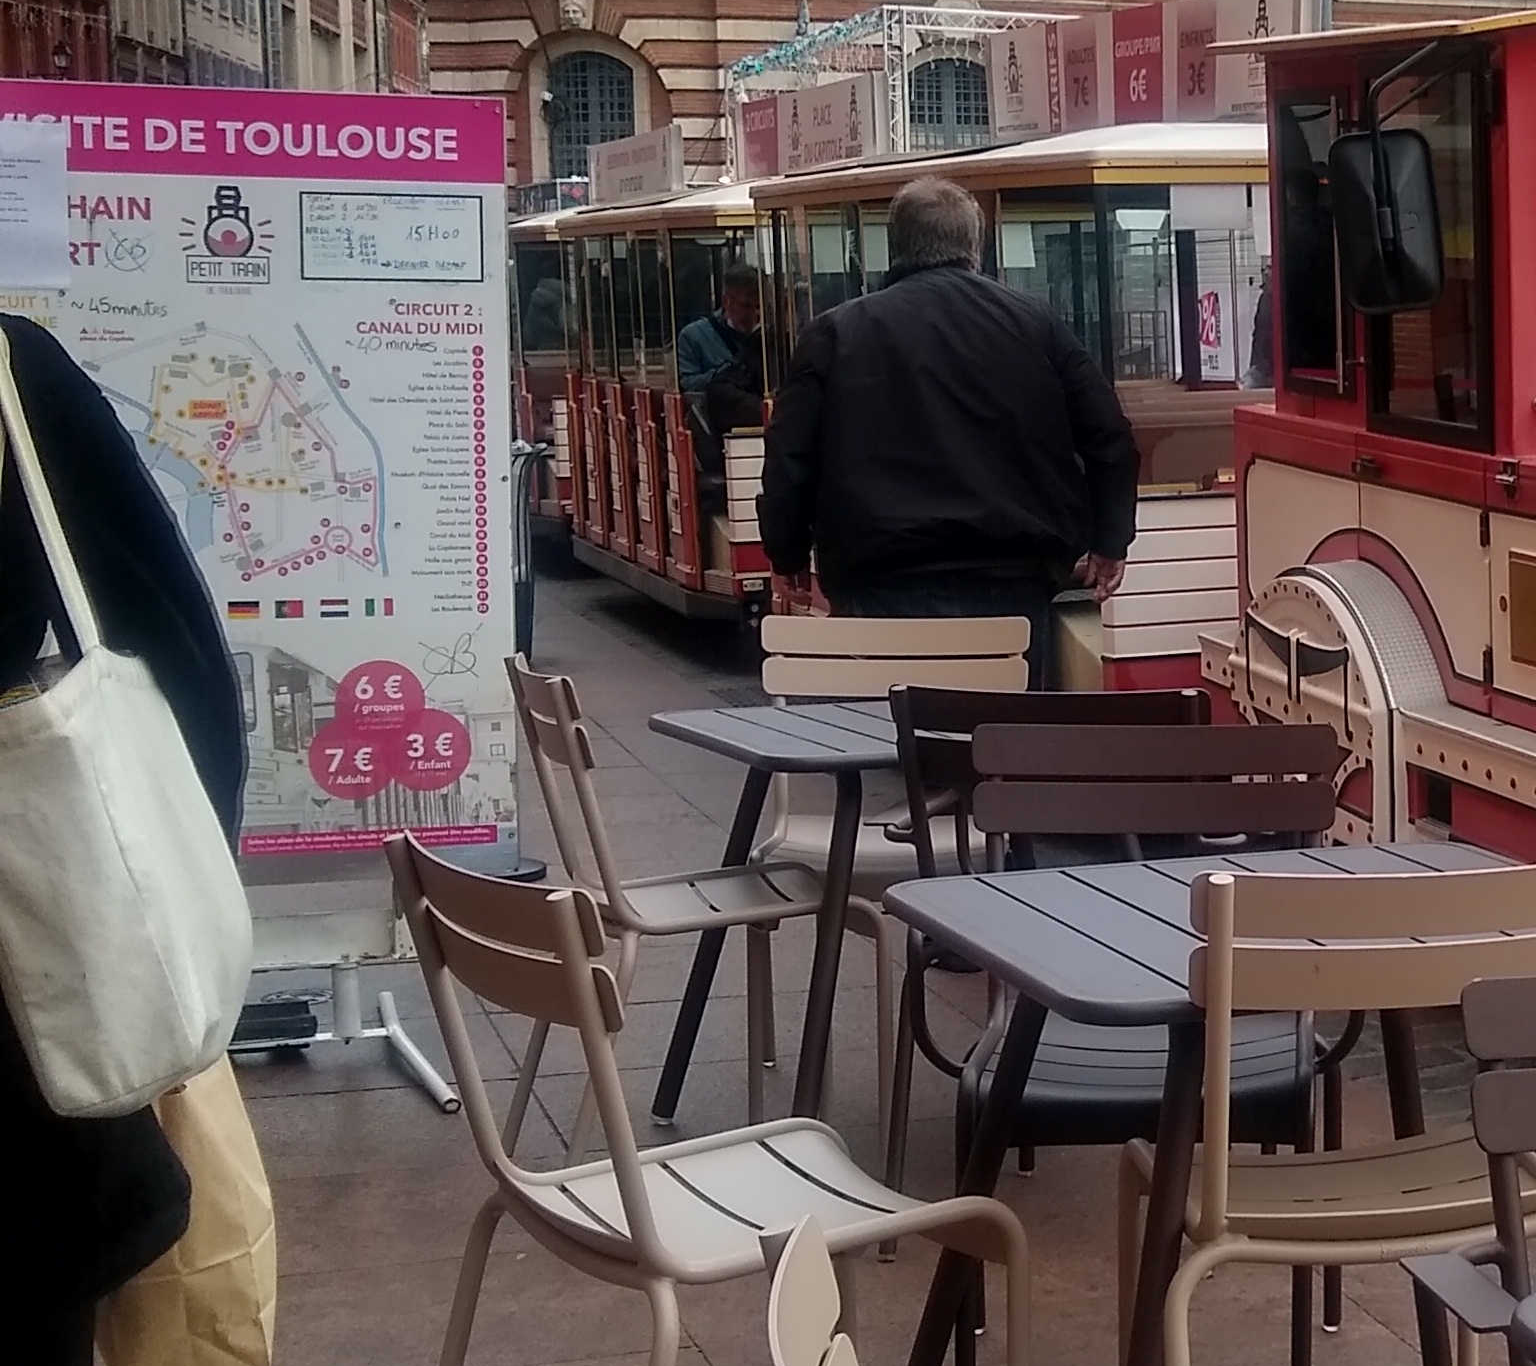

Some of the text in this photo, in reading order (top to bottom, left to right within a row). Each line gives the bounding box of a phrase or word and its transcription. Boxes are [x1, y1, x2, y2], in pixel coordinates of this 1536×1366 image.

[1067, 46, 1094, 66] ADULTES
[1114, 36, 1161, 58] GROUPE/PMR
[1050, 32, 1060, 132] TARIFS
[1129, 68, 1147, 102] 6€
[1187, 61, 1205, 97] 3€
[1073, 76, 1090, 108] 7€
[813, 104, 832, 126] PLACE
[145, 118, 206, 154] DE
[216, 120, 459, 162] TOULOUSE
[813, 138, 842, 162] CAPITOLE
[191, 261, 266, 277] PETIT TRAIN
[394, 303, 460, 317] CIRCUIT
[464, 304, 473, 316] 2
[356, 321, 483, 336] CANAL DU MIDI
[354, 675, 403, 700] 6 €
[362, 703, 405, 714] groupes
[406, 732, 453, 758] 3 €
[325, 747, 374, 773] 7 €
[417, 760, 451, 770] Enfant
[336, 775, 371, 785] Adulte
